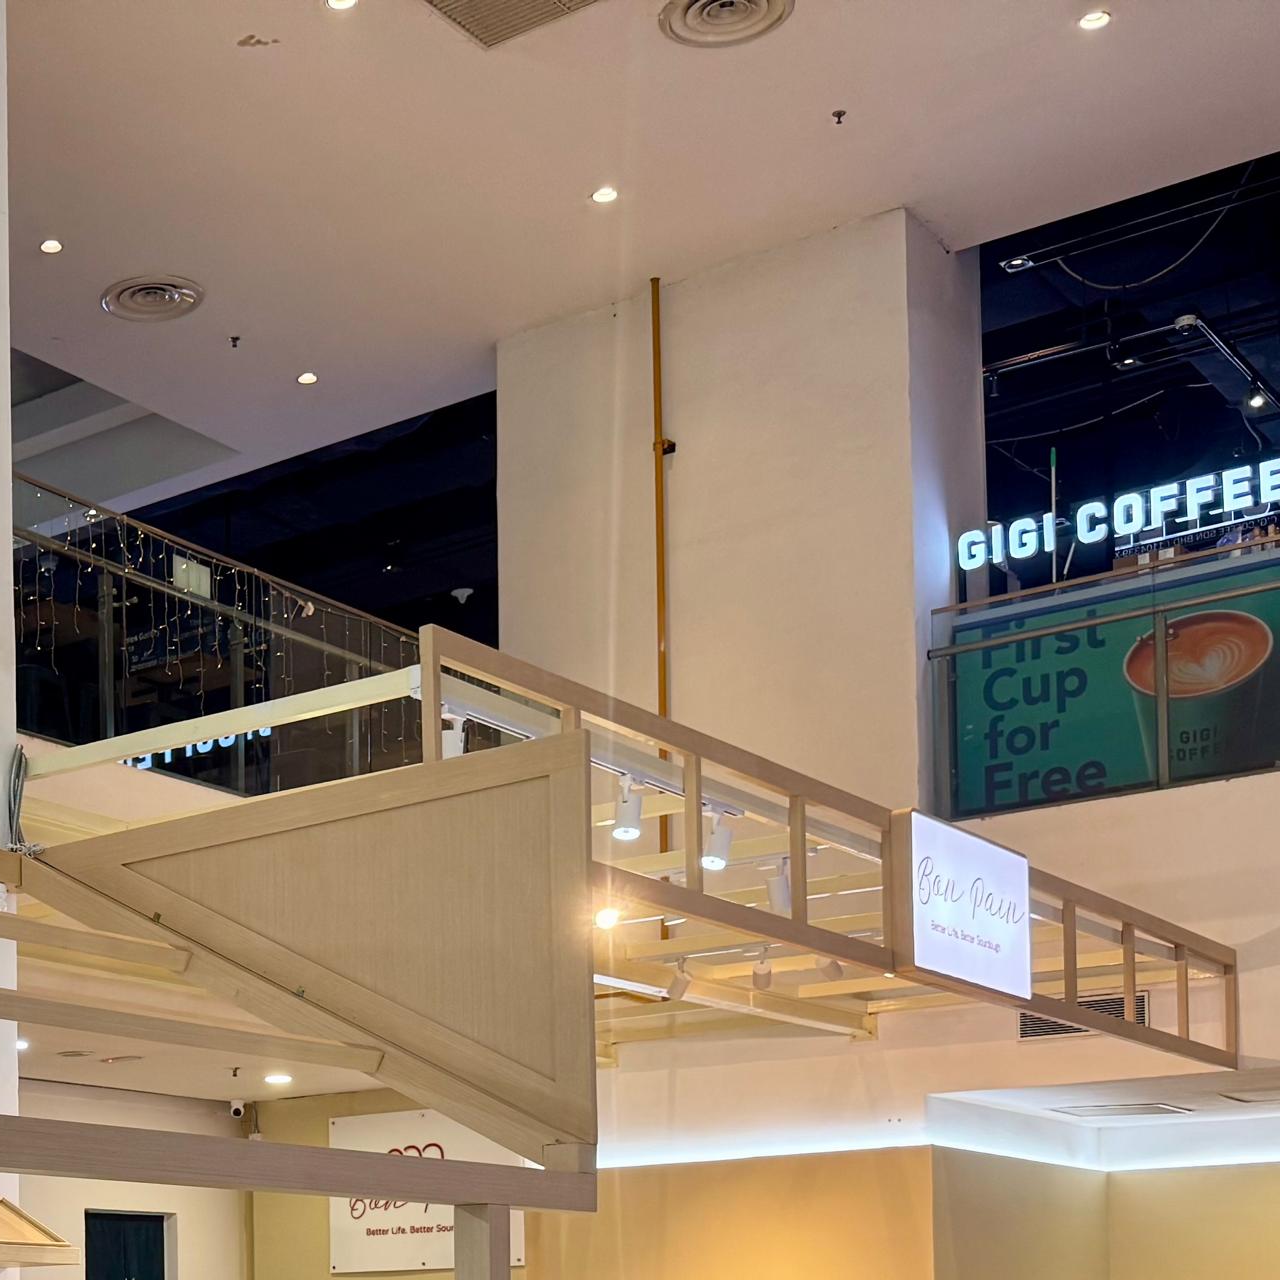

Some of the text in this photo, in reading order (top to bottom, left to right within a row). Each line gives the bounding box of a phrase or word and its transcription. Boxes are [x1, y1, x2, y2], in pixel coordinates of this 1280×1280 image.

[957, 458, 1280, 571] GIGI COFFEE
[981, 609, 1106, 670] First
[982, 665, 1088, 713] Cup
[983, 715, 1060, 759] for
[1179, 726, 1218, 744] GIGI
[983, 760, 1108, 806] Free
[917, 856, 1025, 924] Bon Pain
[366, 1224, 454, 1236] Better Life. Better Sour
